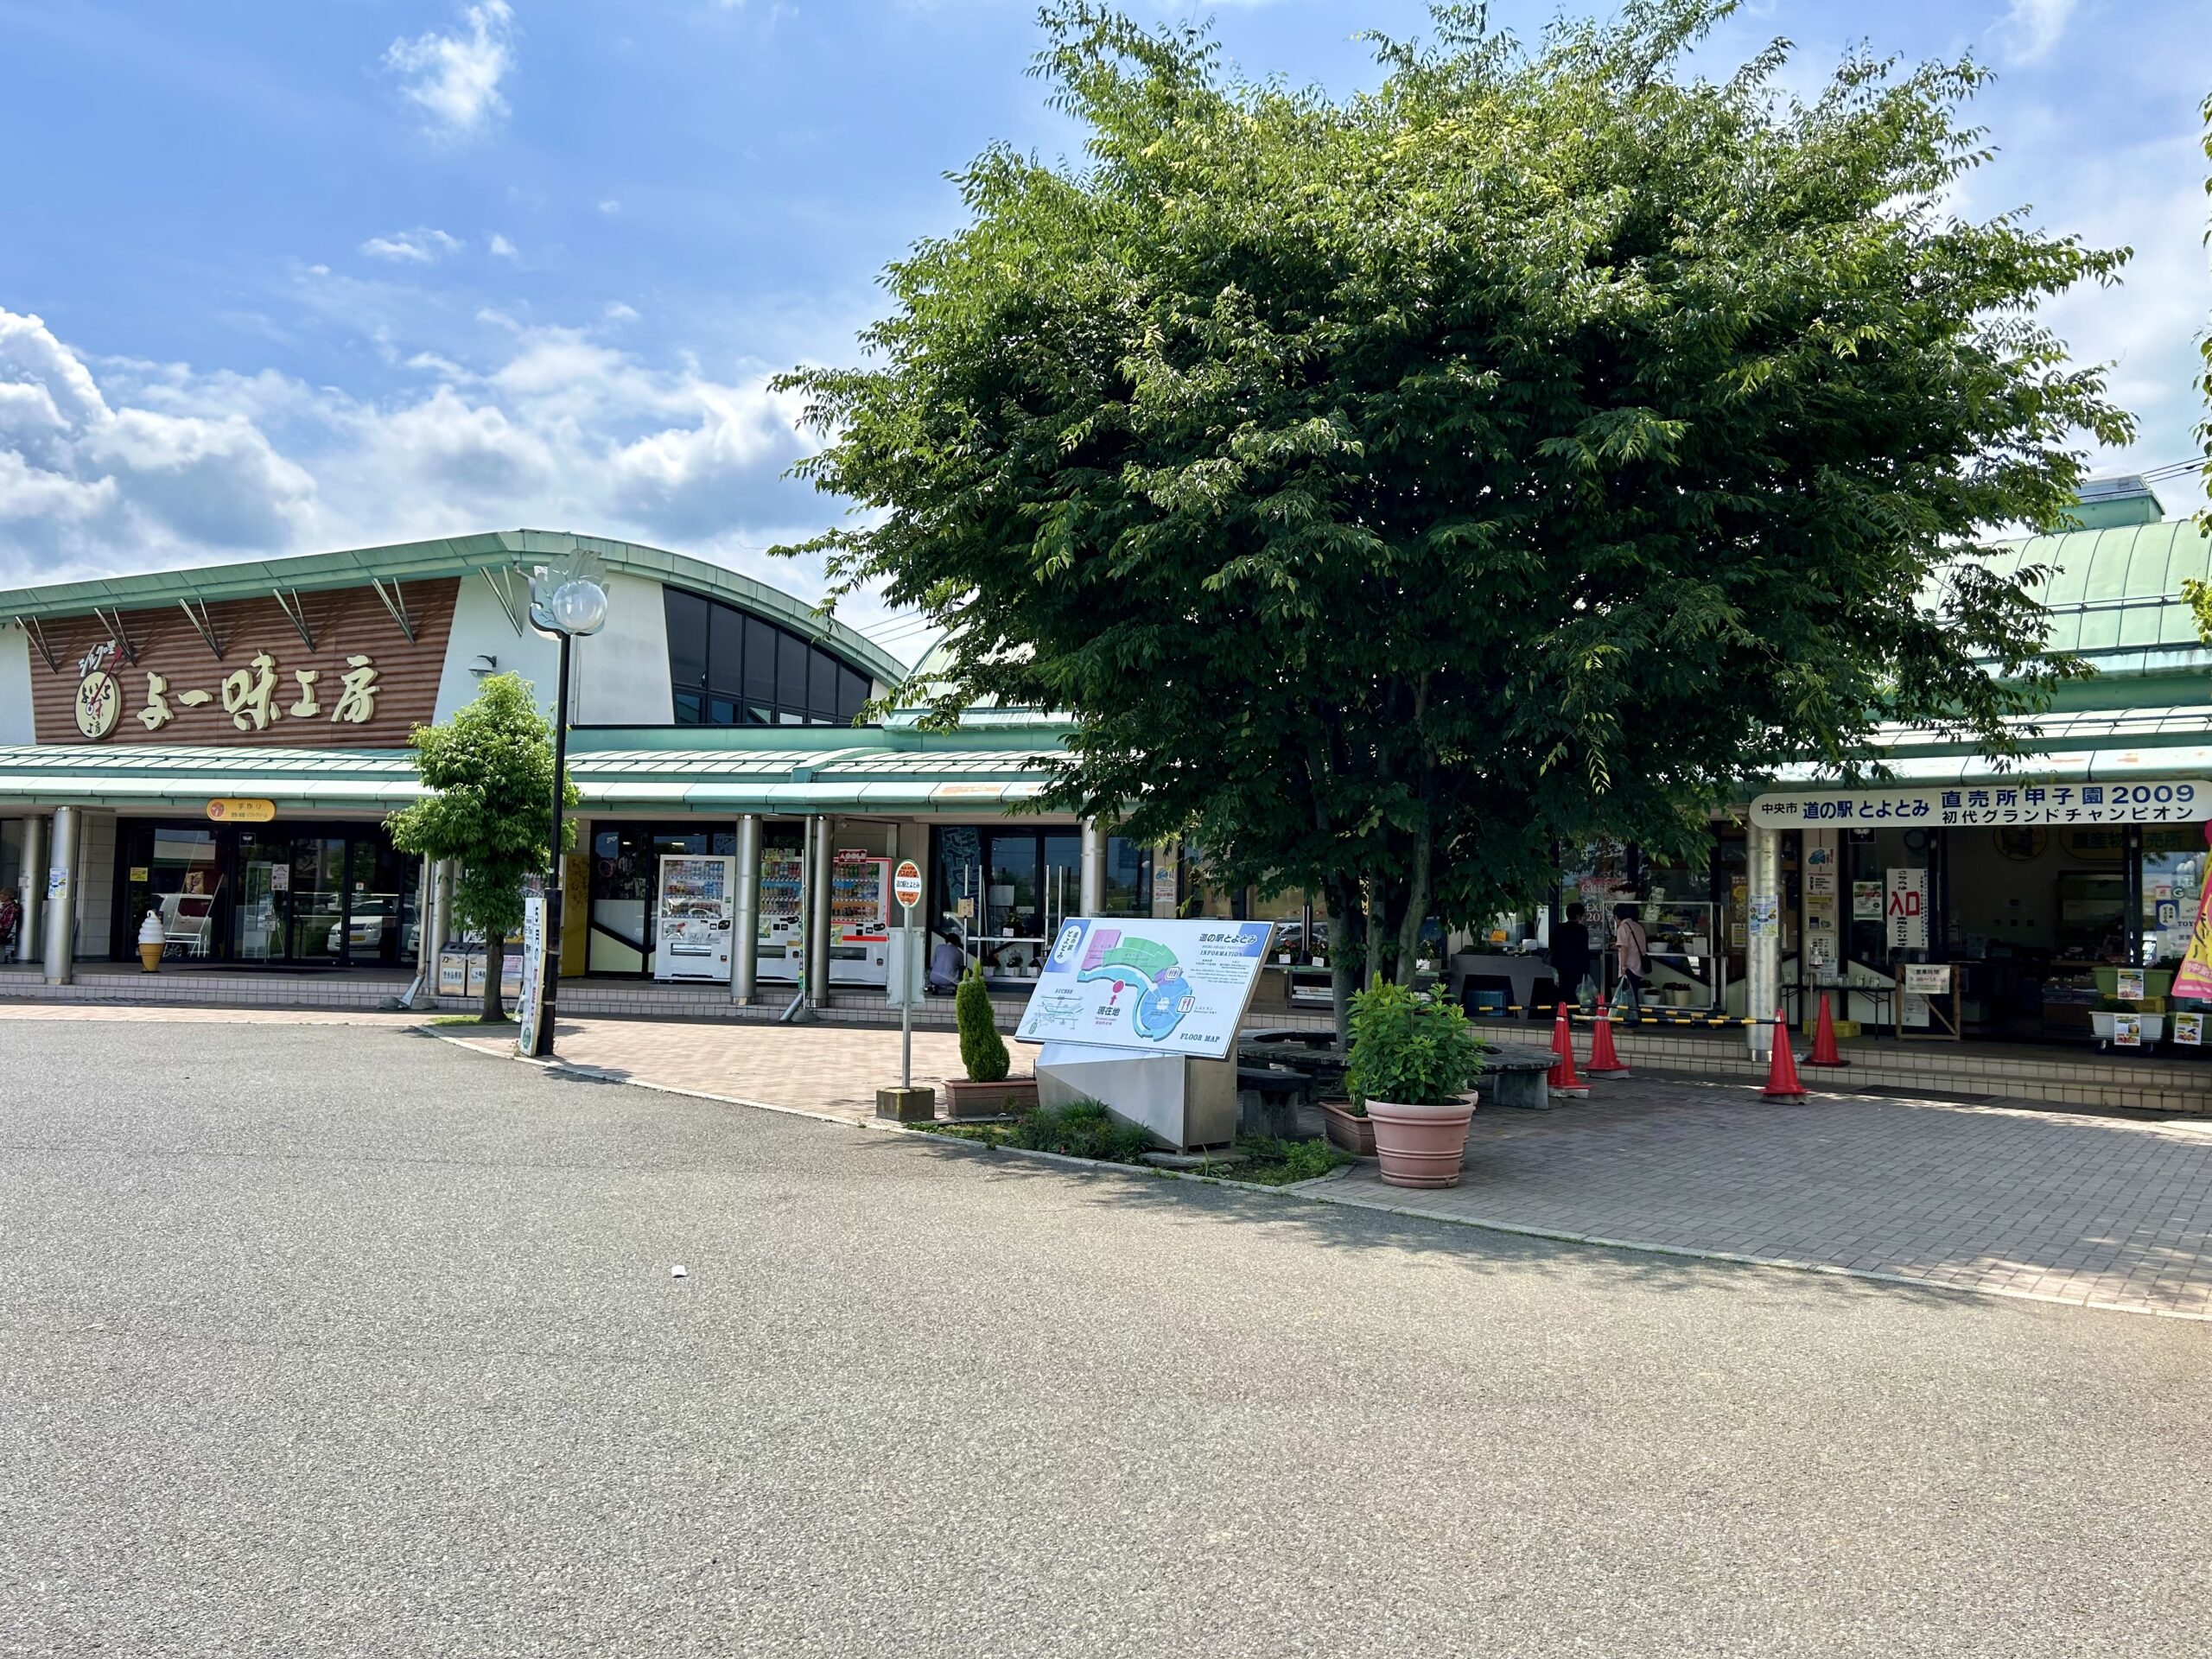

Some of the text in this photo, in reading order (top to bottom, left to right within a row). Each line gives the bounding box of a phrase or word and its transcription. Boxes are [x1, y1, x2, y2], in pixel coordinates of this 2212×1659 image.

[137, 649, 380, 732] 与一味工房
[1941, 785, 2194, 808] 直売所甲子園2009
[1762, 799, 1929, 819] 中央市 道の駅とよとみ
[1942, 806, 2194, 824] 初代グランドチャンピオン
[2071, 830, 2184, 849] 農産物売所
[1888, 891, 1920, 916] 入口
[1057, 931, 1079, 959] 道の駅 とよとみ
[1198, 933, 1256, 944] 道の駅とよとみ
[1096, 1006, 1121, 1016] 現在地
[1180, 1033, 1220, 1043] FLOOR MAP
